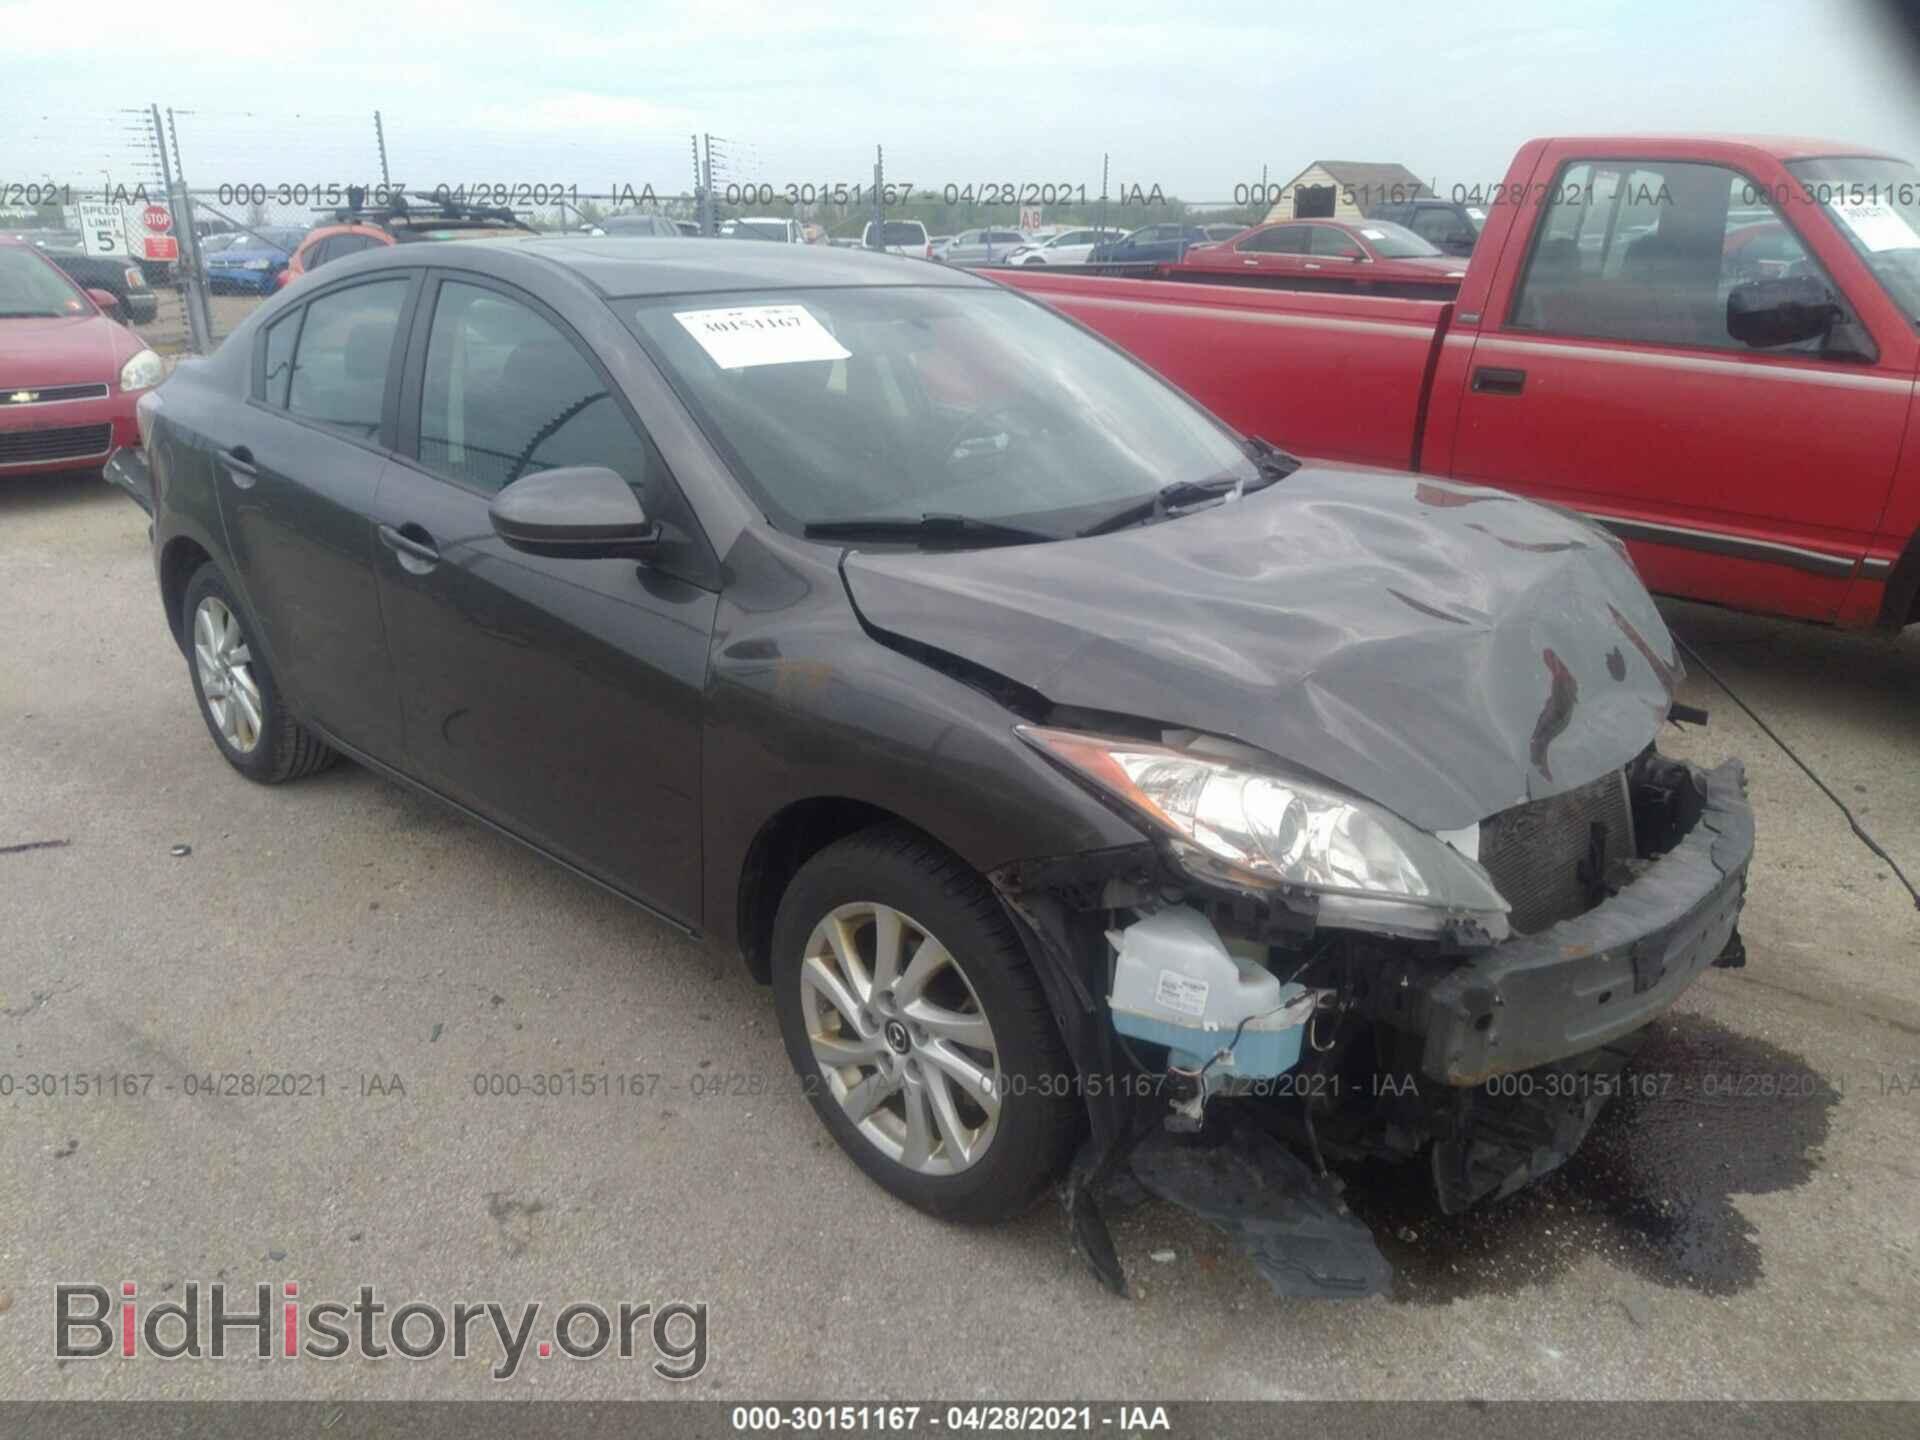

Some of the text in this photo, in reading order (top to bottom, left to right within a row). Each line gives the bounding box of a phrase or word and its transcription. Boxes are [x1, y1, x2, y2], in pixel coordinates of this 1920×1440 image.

[82, 206, 120, 215] SPEED
[87, 218, 117, 228] LIMIT
[144, 213, 169, 225] STOP
[97, 230, 115, 251] 5
